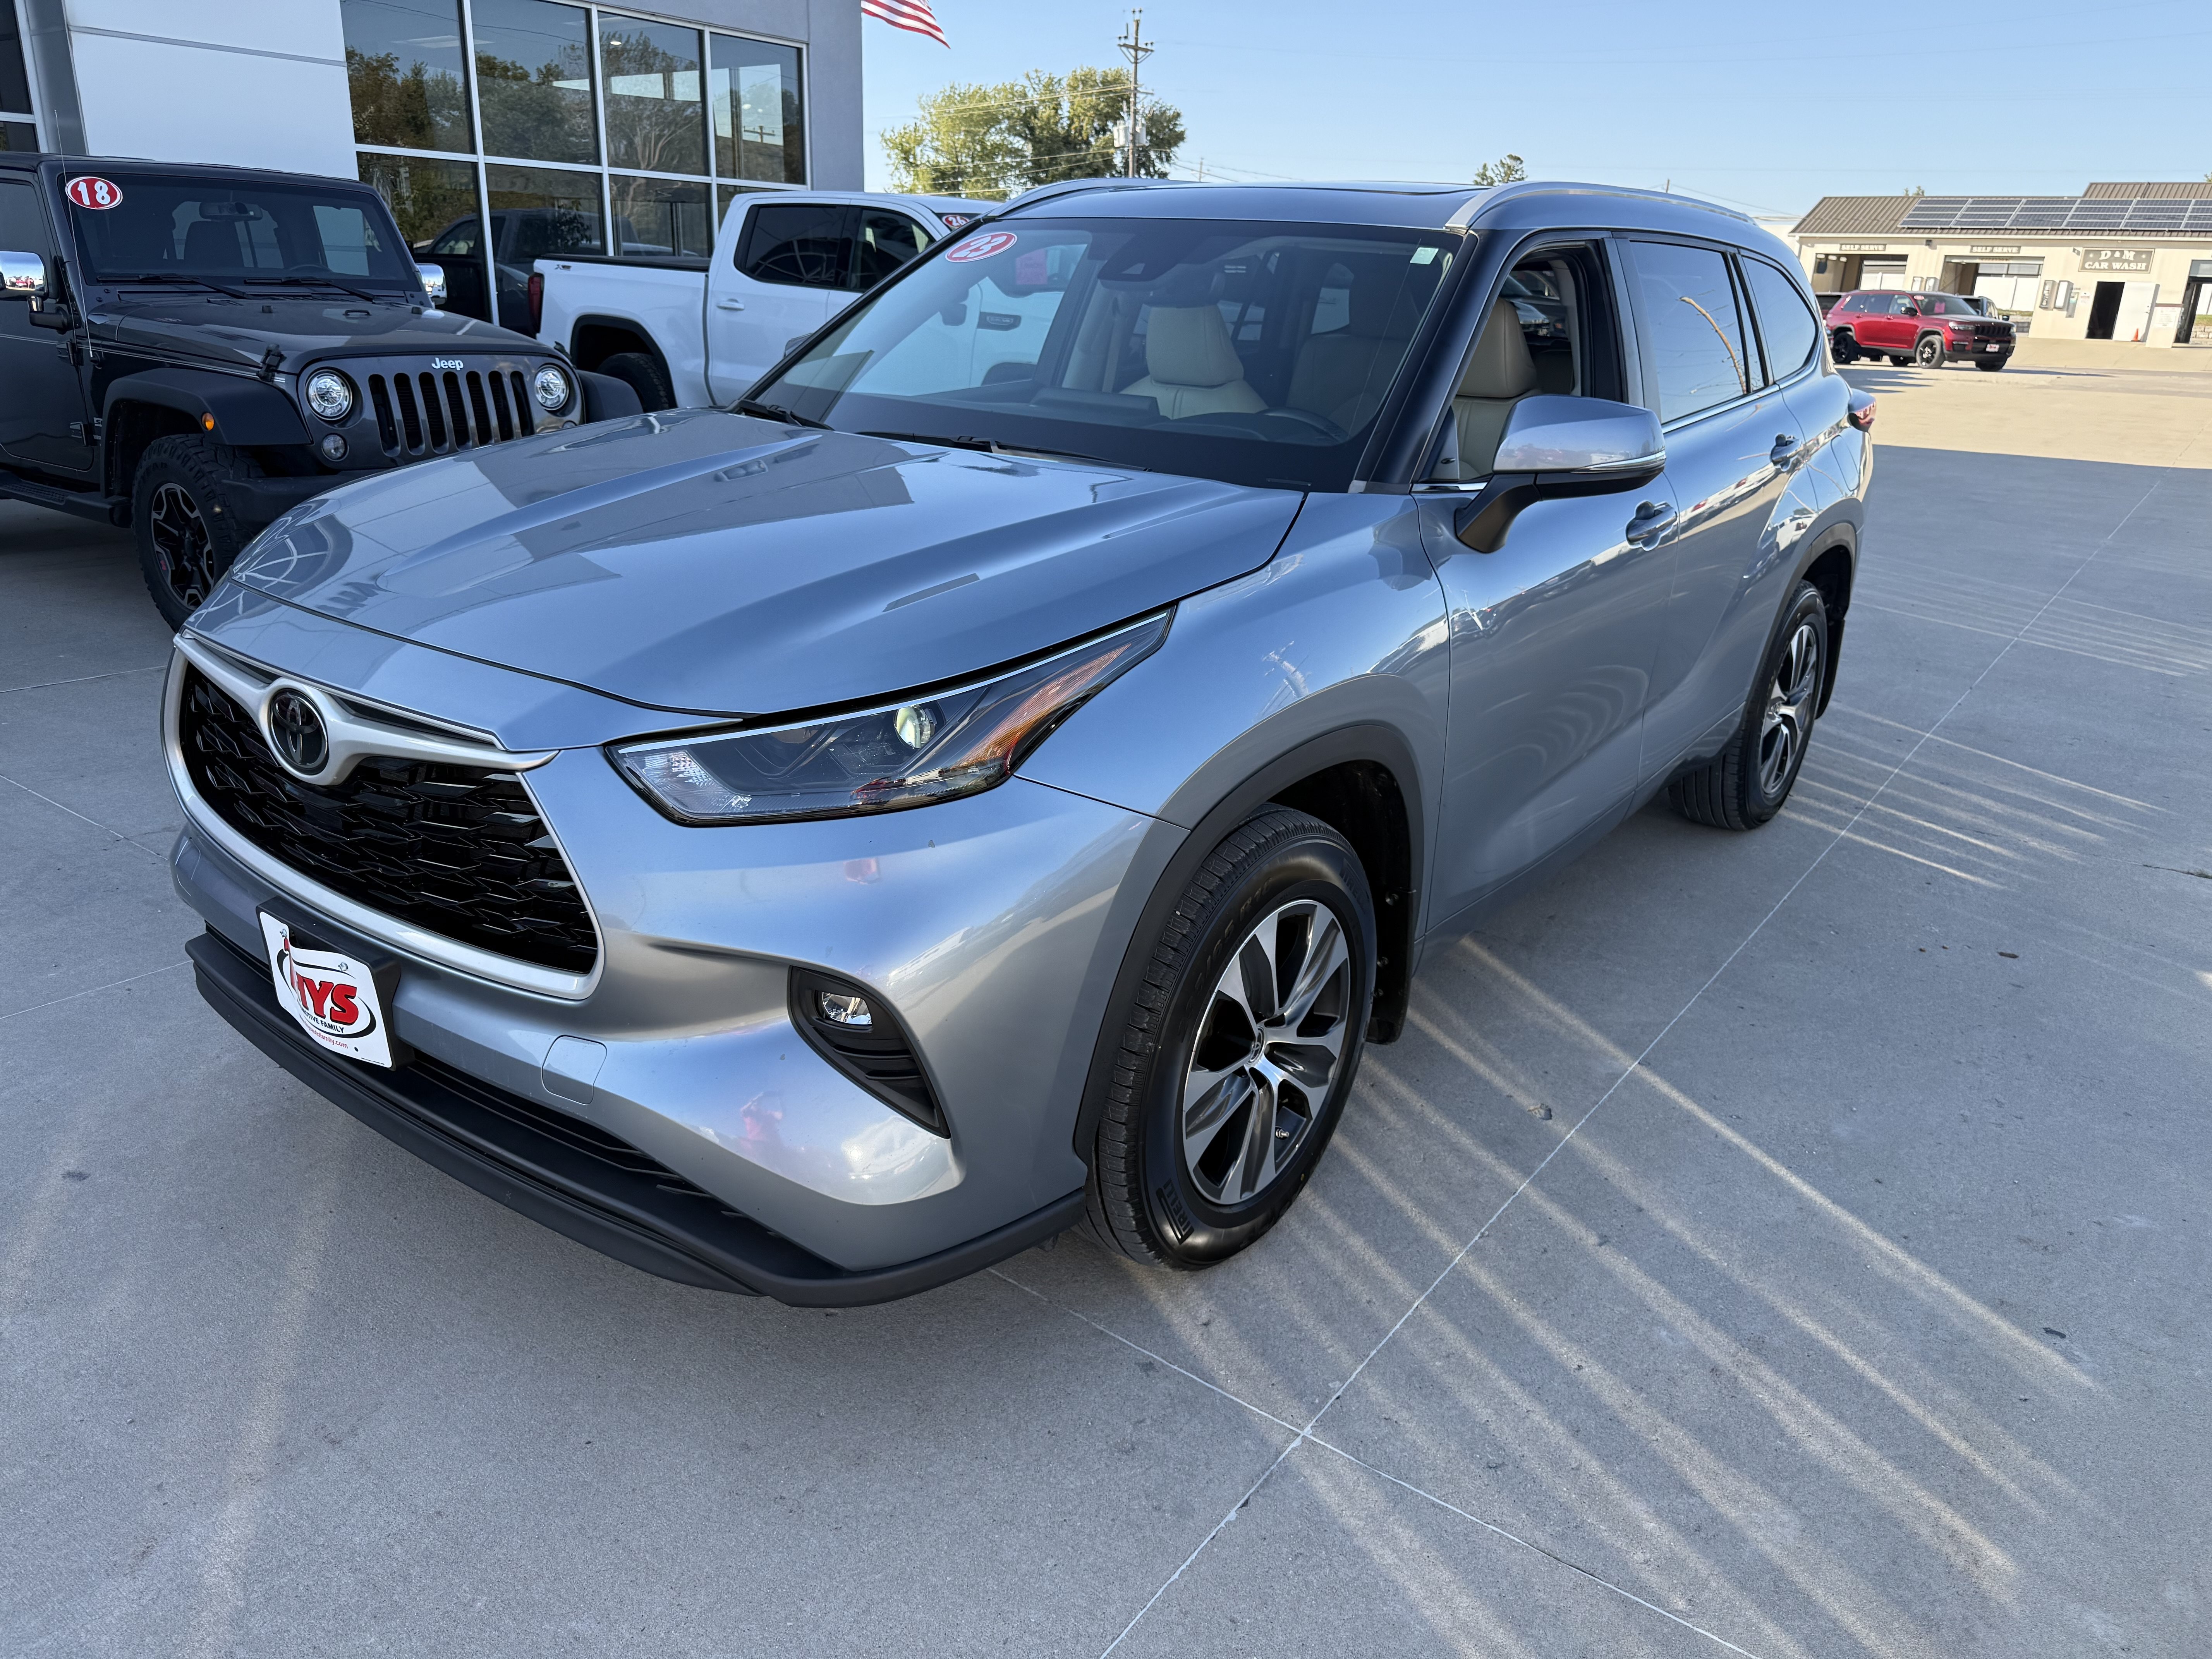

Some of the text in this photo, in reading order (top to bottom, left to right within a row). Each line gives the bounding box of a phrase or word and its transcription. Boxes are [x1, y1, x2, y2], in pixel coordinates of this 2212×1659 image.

[77, 181, 110, 205] 18
[948, 216, 965, 226] 26
[952, 236, 1007, 258] 23
[2099, 251, 2111, 260] D
[2122, 250, 2135, 260] M
[431, 357, 464, 371] Jeep
[320, 1020, 344, 1033] FAMILY
[1156, 1178, 1195, 1245] PIRELLI
